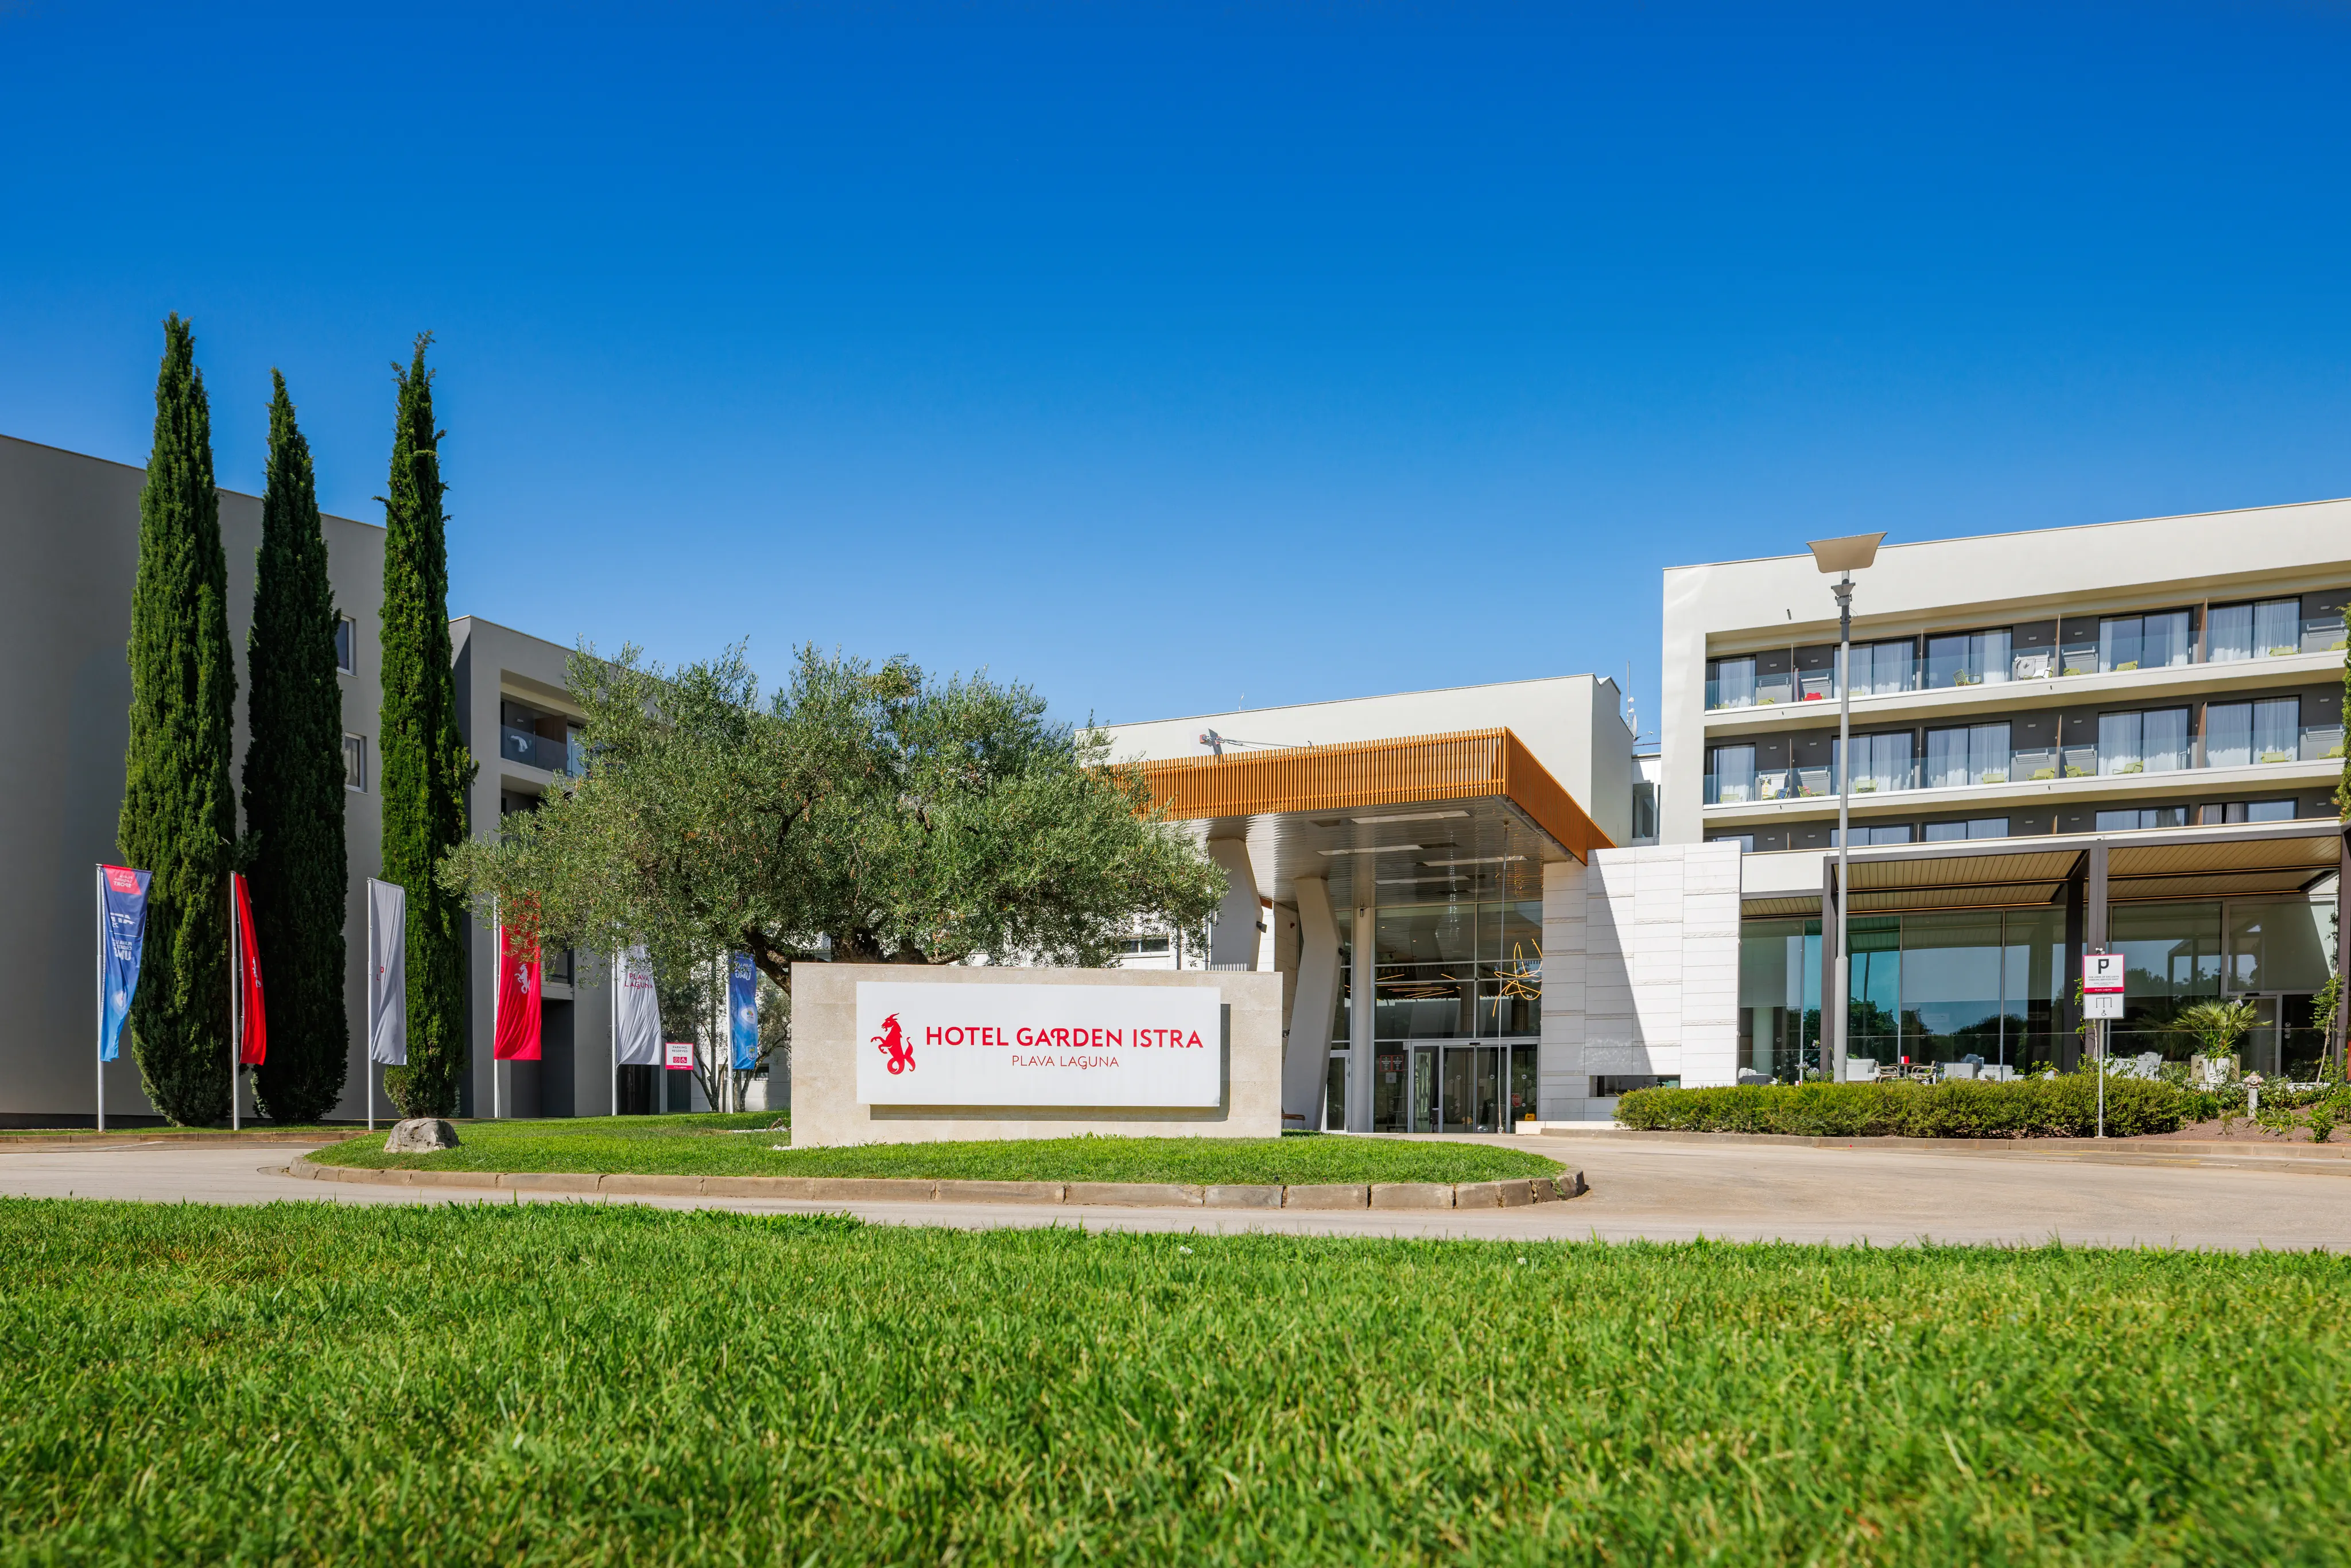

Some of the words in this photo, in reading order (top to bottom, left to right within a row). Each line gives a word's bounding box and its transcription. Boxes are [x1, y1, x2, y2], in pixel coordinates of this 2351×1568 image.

[2098, 959, 2109, 974] P
[629, 973, 649, 981] PLAVA
[624, 981, 653, 989] LAGUNA
[926, 1026, 1009, 1046] HOTEL
[1016, 1027, 1122, 1047] GARDEN
[1133, 1029, 1204, 1048] ISTRA
[1012, 1055, 1055, 1066] PLAVA
[1060, 1055, 1119, 1070] LAGUNA
